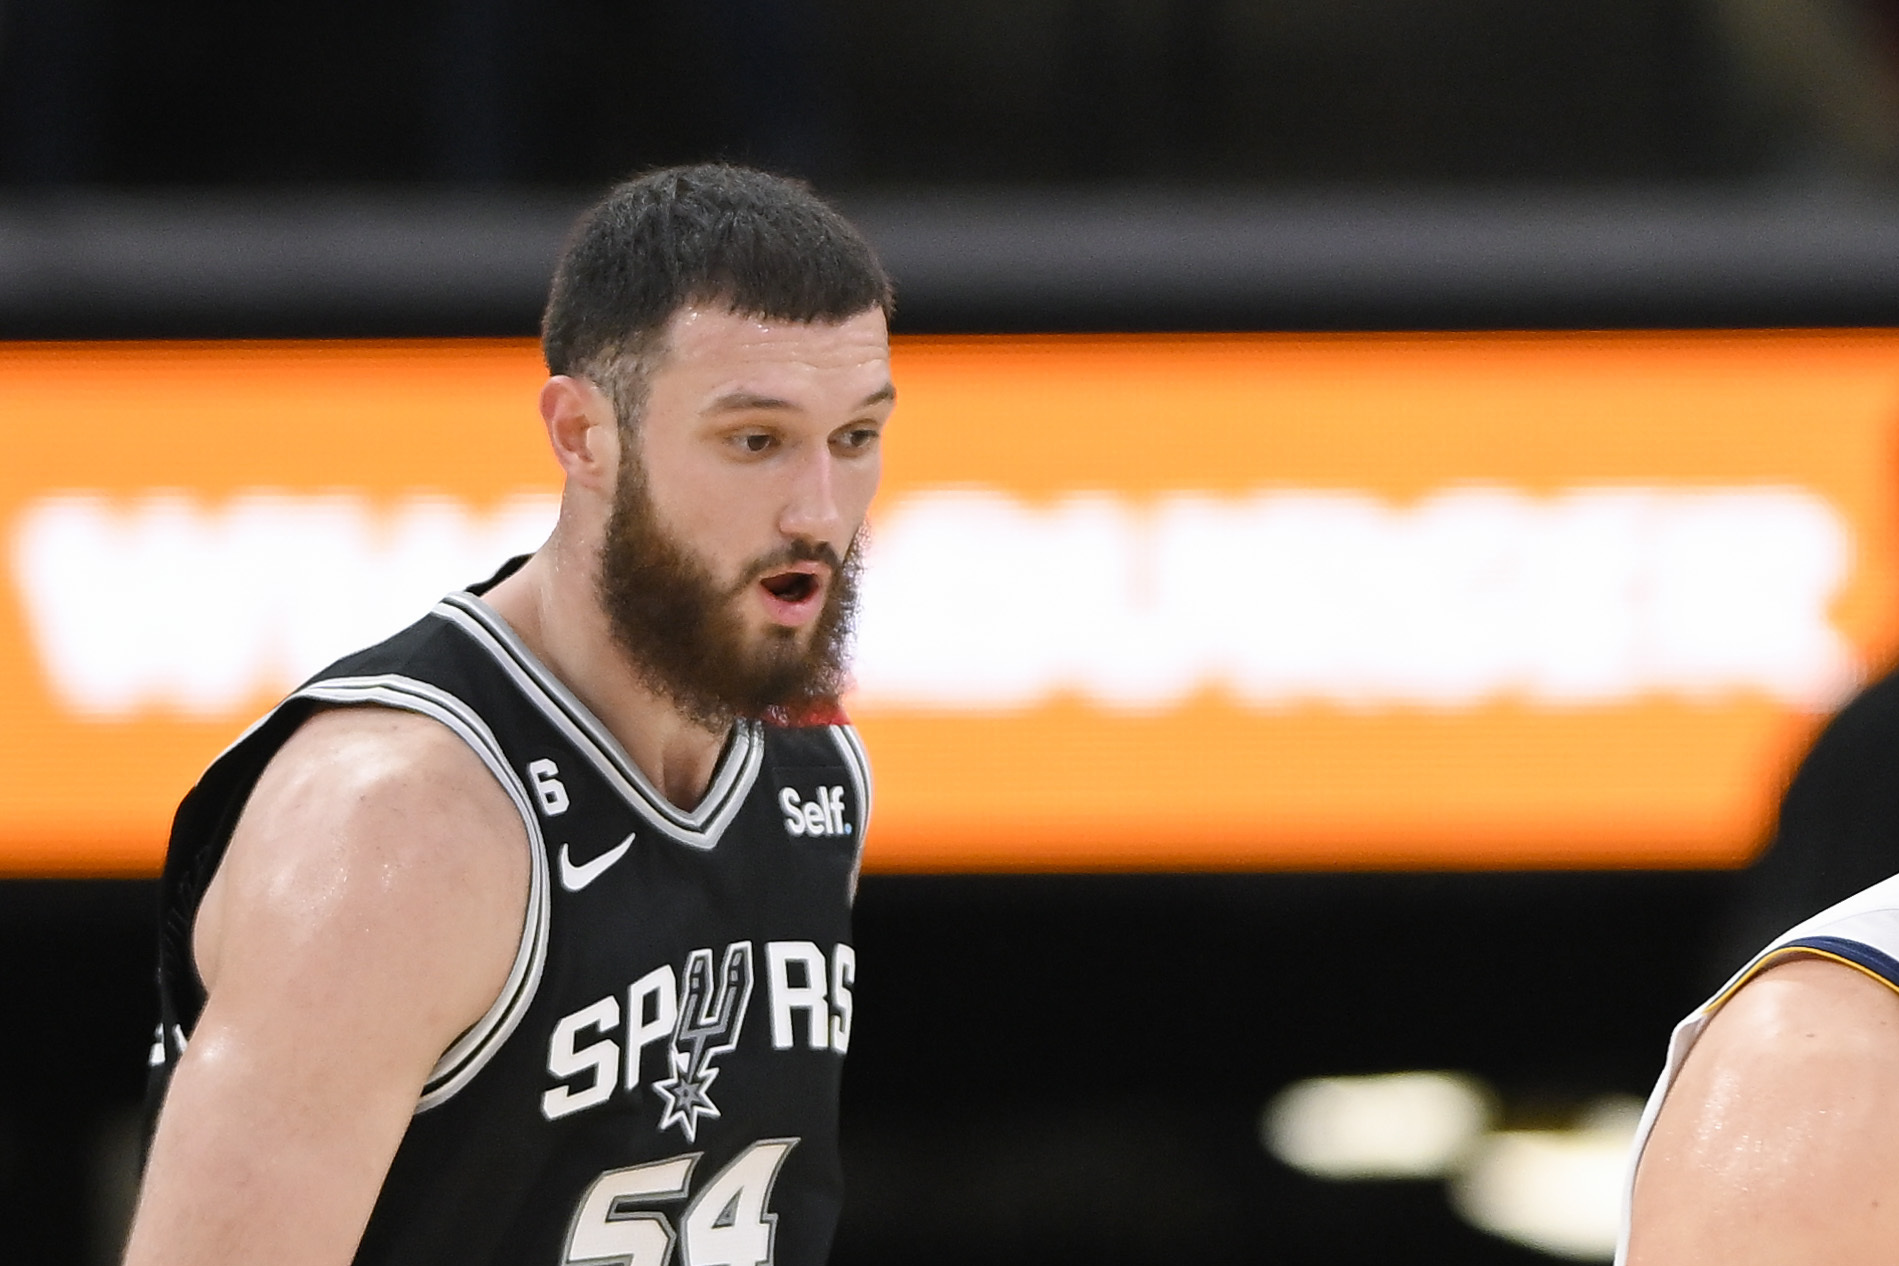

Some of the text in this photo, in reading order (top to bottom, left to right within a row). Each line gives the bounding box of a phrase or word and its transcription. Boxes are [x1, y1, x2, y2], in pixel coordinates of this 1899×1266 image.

[527, 758, 569, 816] 6
[780, 785, 853, 836] Self.
[540, 940, 857, 1143] SPURS
